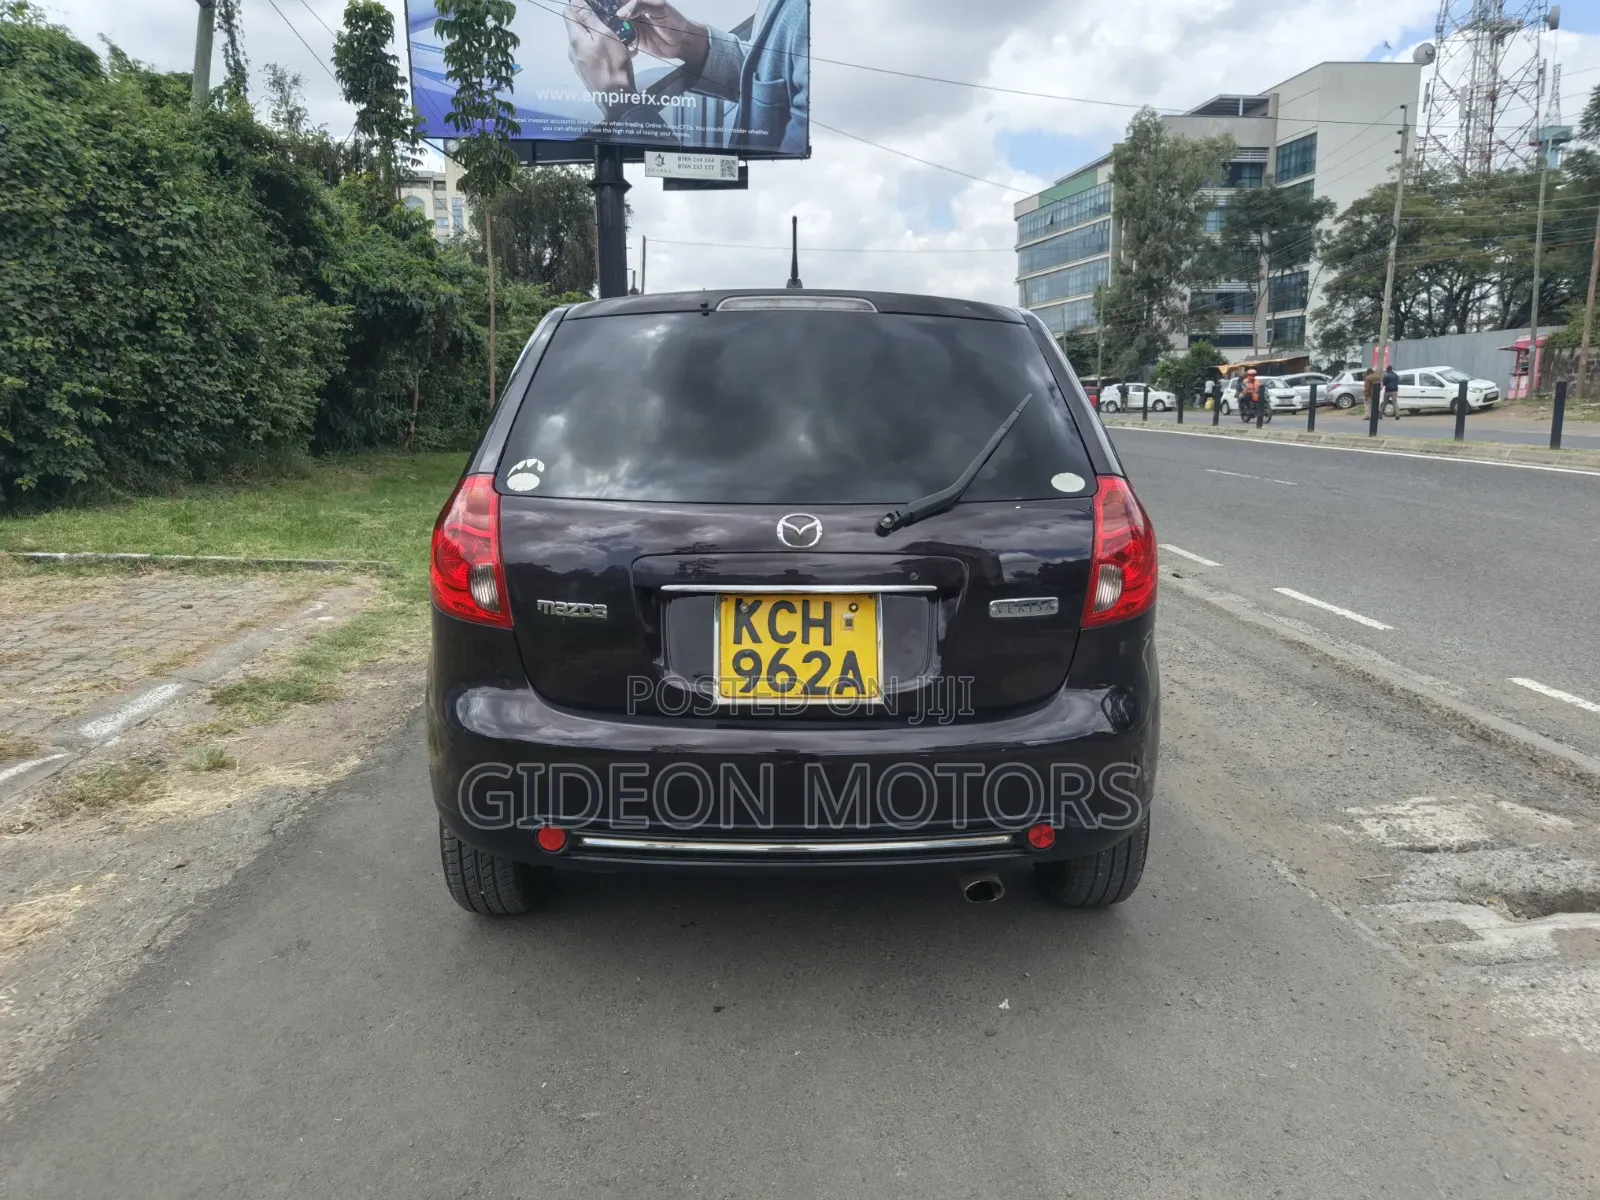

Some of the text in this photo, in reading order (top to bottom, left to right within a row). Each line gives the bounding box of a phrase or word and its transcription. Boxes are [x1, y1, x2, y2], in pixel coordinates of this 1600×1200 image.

[535, 89, 697, 108] www.empirefx.com
[612, 128, 625, 136] high
[642, 129, 658, 137] losing
[625, 121, 644, 129] trading
[996, 602, 1057, 614] VERISA
[732, 598, 832, 646] KCH
[732, 648, 867, 695] 962A
